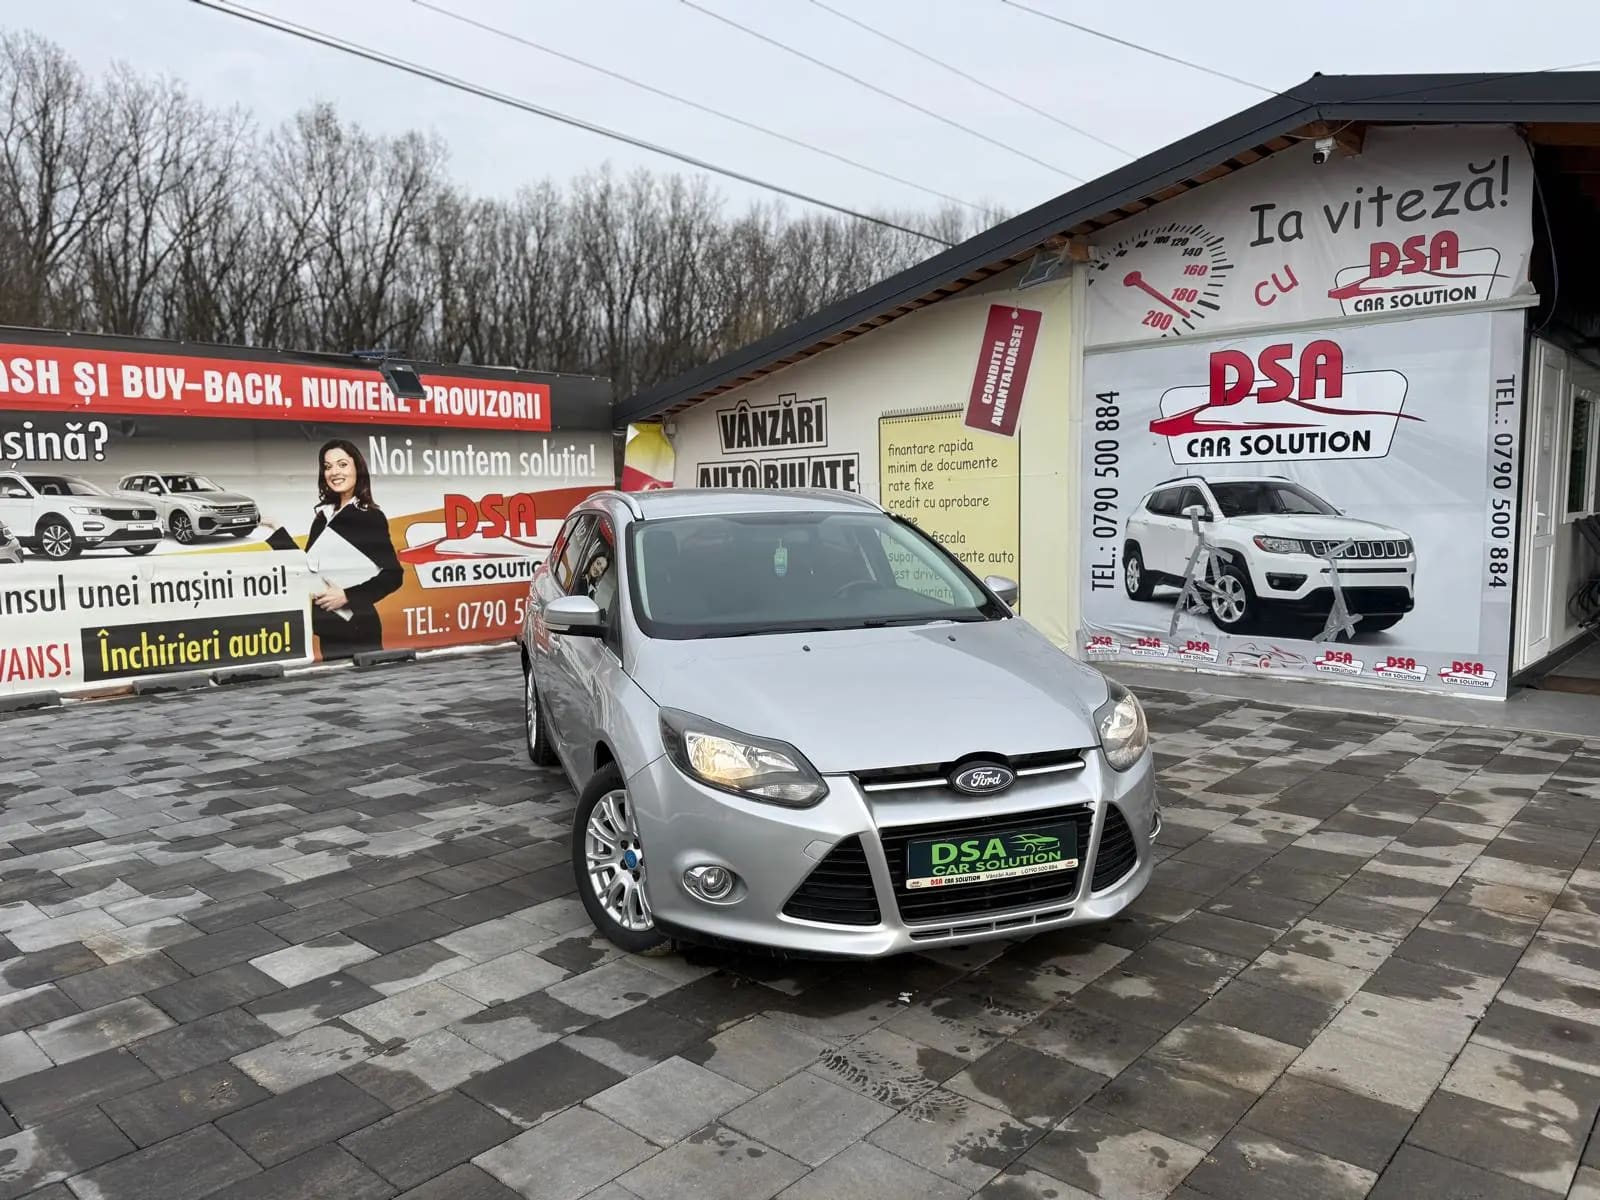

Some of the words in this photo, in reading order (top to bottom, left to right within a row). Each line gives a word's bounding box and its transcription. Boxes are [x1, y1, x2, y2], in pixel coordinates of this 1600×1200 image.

[1249, 203, 1304, 248] Ia
[1323, 155, 1510, 234] viteză!
[1170, 237, 1190, 247] 120
[1181, 247, 1204, 257] 140
[1369, 230, 1460, 279] DSA
[1183, 263, 1209, 276] 160
[1255, 264, 1300, 307] cu
[1170, 287, 1199, 303] 180
[1354, 295, 1385, 313] CAR
[1390, 285, 1478, 308] SOLUTION
[1141, 309, 1174, 331] 200
[991, 324, 1025, 427] AVANTAJOASE!
[1209, 339, 1344, 407] DSA
[121, 364, 293, 409] BUY-BACK,
[419, 384, 541, 420] PROVIZORII
[1494, 374, 1516, 425] TEL.:
[720, 400, 824, 449] VÂNZĂRI
[1095, 390, 1120, 432] 884
[0, 421, 109, 469] șină?
[369, 435, 412, 477] Noi
[423, 444, 512, 477] suntem
[888, 443, 936, 457] finantare
[938, 438, 974, 456] rapida
[1094, 439, 1120, 478] 500
[1187, 437, 1231, 459] CAR
[1239, 429, 1371, 456] SOLUTION
[888, 461, 918, 475] minim
[920, 460, 934, 473] de
[936, 456, 999, 472] documente
[1493, 433, 1514, 490] 0790
[888, 481, 911, 492] rate
[914, 477, 935, 492] fixe
[444, 492, 538, 540] DSA
[888, 496, 921, 510] credit
[923, 498, 936, 509] cu
[938, 494, 990, 512] aprobare
[1093, 487, 1118, 538] 0790
[1491, 498, 1511, 539] 500
[988, 550, 1015, 563] auto
[1092, 546, 1117, 592] TEL.:
[1488, 547, 1510, 589] 884
[0, 574, 66, 616] nsul
[78, 575, 139, 609] unei
[150, 569, 233, 610] mașini
[243, 565, 289, 597] noi!
[431, 565, 467, 583] CAR
[403, 605, 451, 636] TEL.:
[457, 599, 507, 630] 0790
[514, 597, 529, 625] 5
[97, 628, 221, 674] Închirieri
[229, 621, 292, 658] auto!
[1186, 640, 1210, 652] DSA
[1325, 650, 1353, 664] DSA
[1386, 656, 1416, 670] DSA
[1452, 661, 1484, 676] DSA
[970, 770, 1002, 787] Ford
[931, 837, 1008, 865] DSA
[932, 863, 971, 876] CAR
[976, 850, 1062, 872] SOLUTION
[930, 878, 943, 886] DSA
[955, 875, 981, 884] SOLUTION
